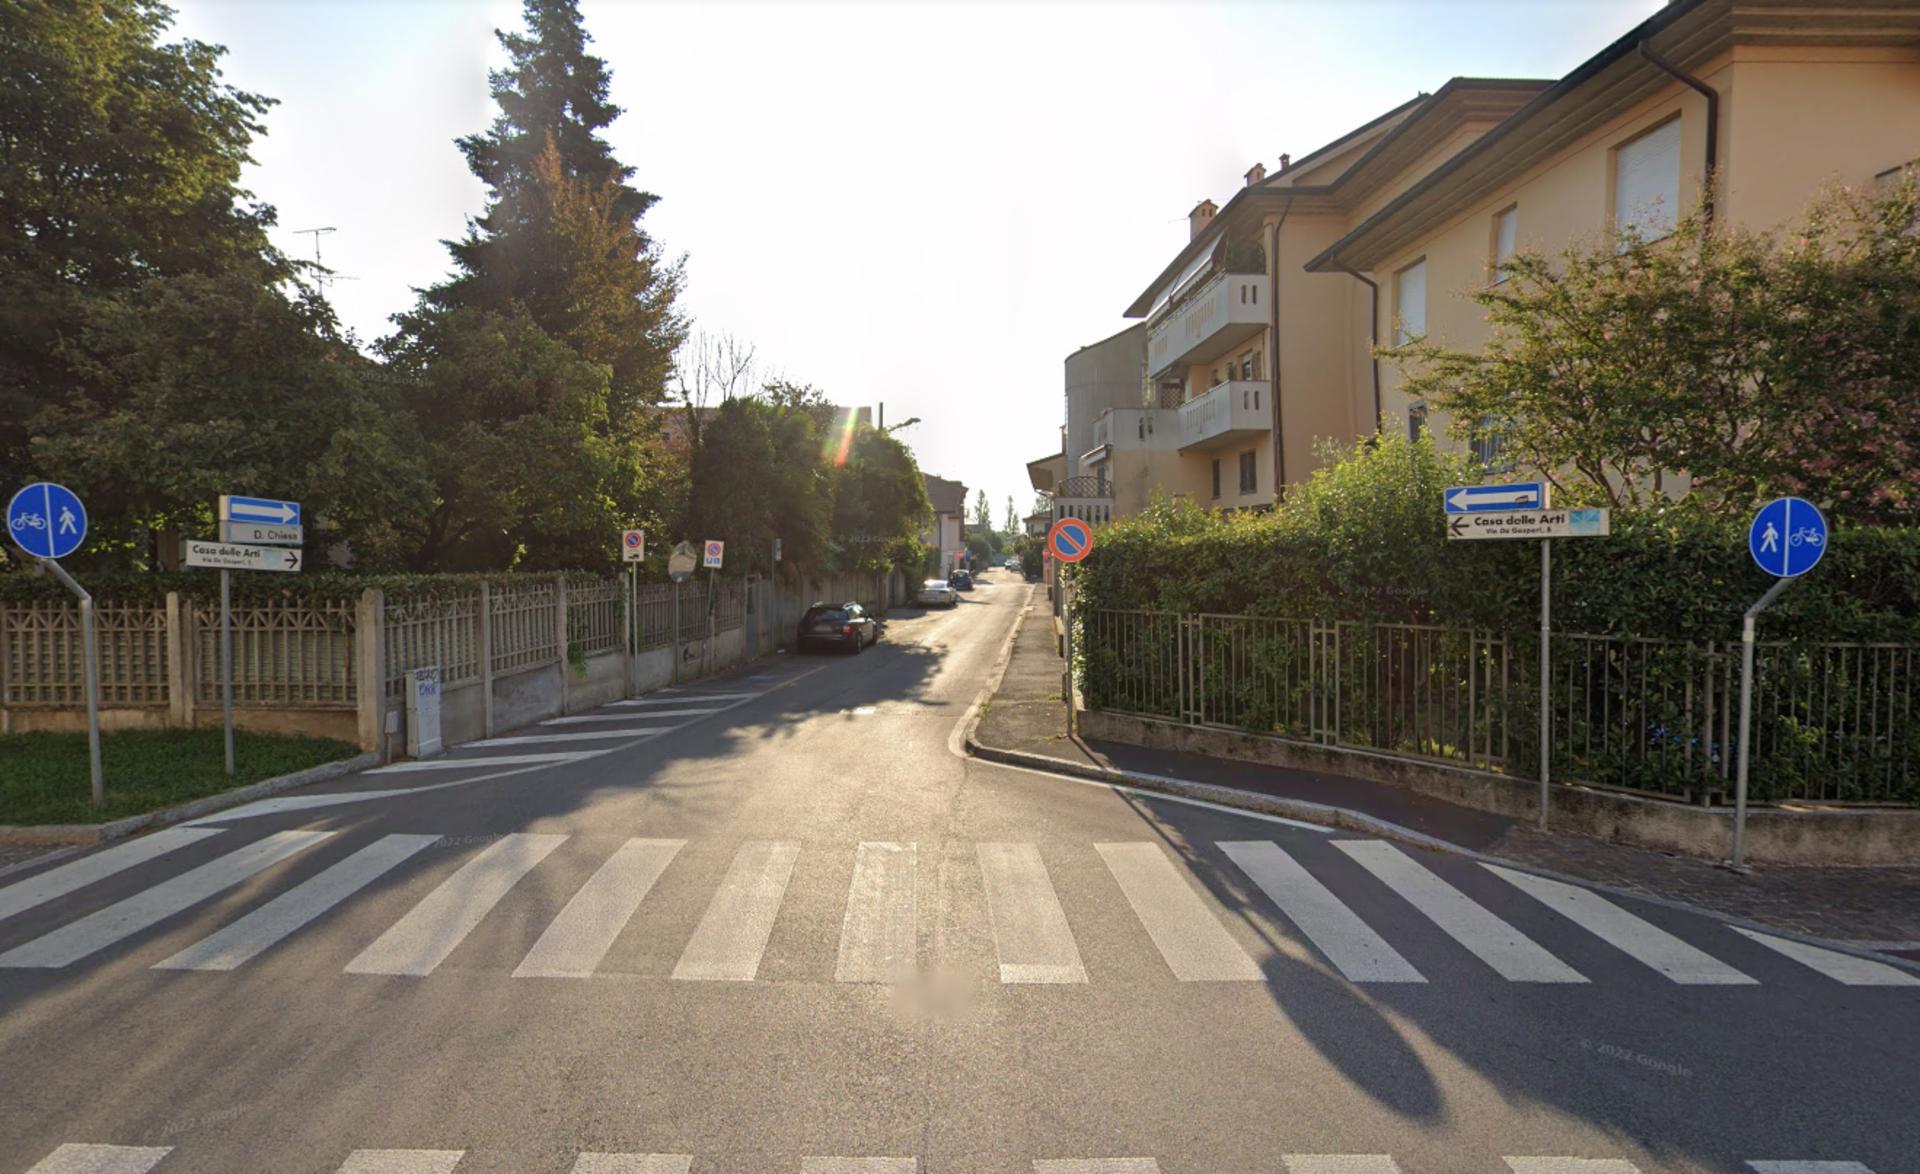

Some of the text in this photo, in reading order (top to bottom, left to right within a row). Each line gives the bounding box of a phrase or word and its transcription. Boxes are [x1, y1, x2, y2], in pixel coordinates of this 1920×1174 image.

[1474, 513, 1565, 526] Casa delle Arti
[253, 529, 298, 540] D. Chiesa
[192, 544, 261, 558] Casa delle Arti
